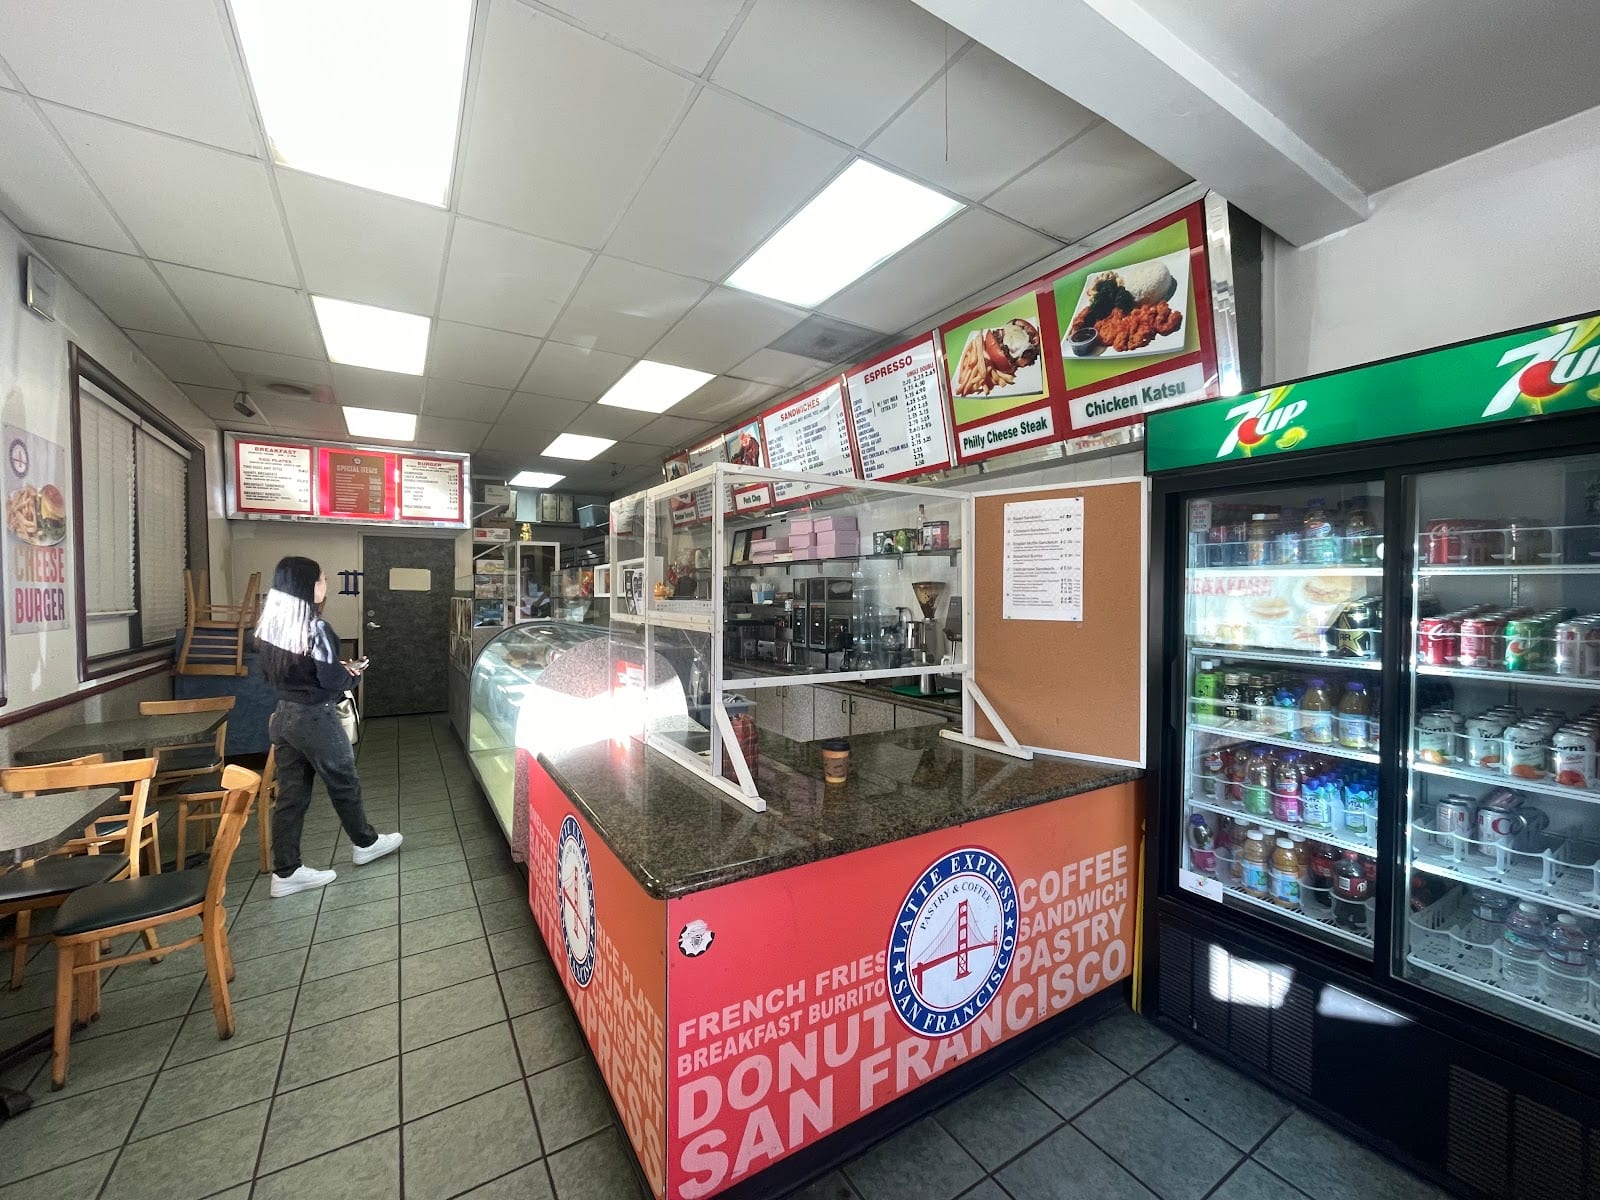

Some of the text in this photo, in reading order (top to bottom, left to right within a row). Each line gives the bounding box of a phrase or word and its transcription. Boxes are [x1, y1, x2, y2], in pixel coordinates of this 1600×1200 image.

[864, 356, 912, 384] ESPRESSO
[1085, 380, 1185, 418] Chicken Katsu
[1481, 325, 1600, 417] 7U
[780, 398, 820, 422] SANDWICHES
[964, 417, 1047, 450] Philly Cheese Steak
[337, 464, 378, 474] SPECIAL ITEMS
[752, 494, 761, 503] Chop
[14, 547, 64, 584] CHEESE
[15, 588, 65, 624] BURGER
[530, 824, 559, 899] BAGEL
[1019, 845, 1128, 907] COFFEE
[893, 854, 1015, 954] LATTE EXPRESS
[920, 881, 992, 930] PASTRY & COFFEE
[1019, 878, 1128, 940] SANDWICH
[596, 919, 662, 1041] RICE PLATE
[1012, 904, 1126, 983] PASTRY
[595, 947, 662, 1086] BURGER
[678, 950, 887, 1049] FRENCH FRIES
[894, 934, 1014, 1034] SAN FRANCISCO
[529, 871, 663, 1197] LATTE EXPRESS
[592, 979, 663, 1129] CROISSANT
[678, 978, 886, 1078] BREAKFAST BURRITO
[678, 938, 1127, 1200] SAN FRANCISCO
[678, 1004, 893, 1138] DONUT
